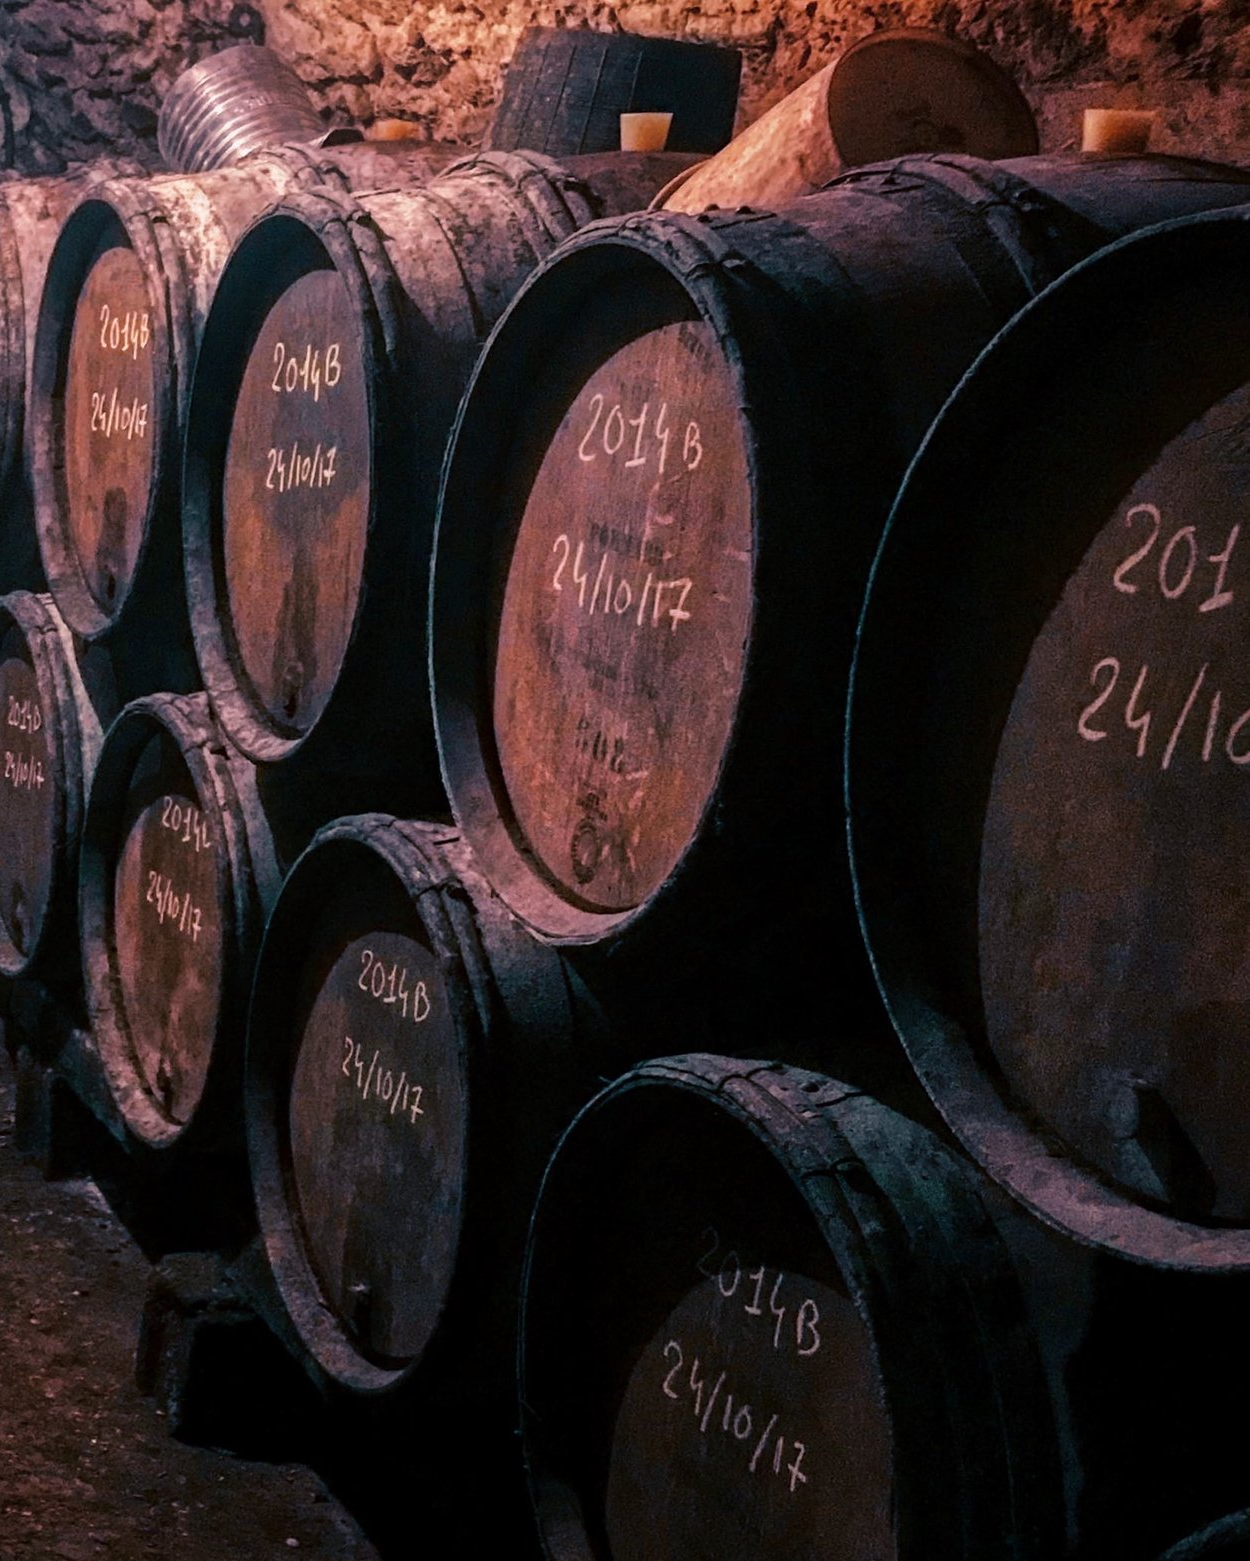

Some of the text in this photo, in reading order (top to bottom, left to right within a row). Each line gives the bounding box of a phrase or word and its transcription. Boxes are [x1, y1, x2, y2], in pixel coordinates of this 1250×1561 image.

[100, 304, 150, 360] 2014B
[270, 341, 342, 402] 2014B
[91, 387, 148, 440] 24/10/17
[578, 392, 703, 474] 2014B
[265, 441, 337, 493] 24/10/17
[552, 531, 693, 635] 24/10/17
[146, 870, 202, 943] 24/10/17
[357, 949, 431, 1023] 2014B
[342, 1035, 425, 1124] 24/10/17
[696, 1224, 821, 1357] 2014B
[662, 1339, 807, 1493] 24/10/17
